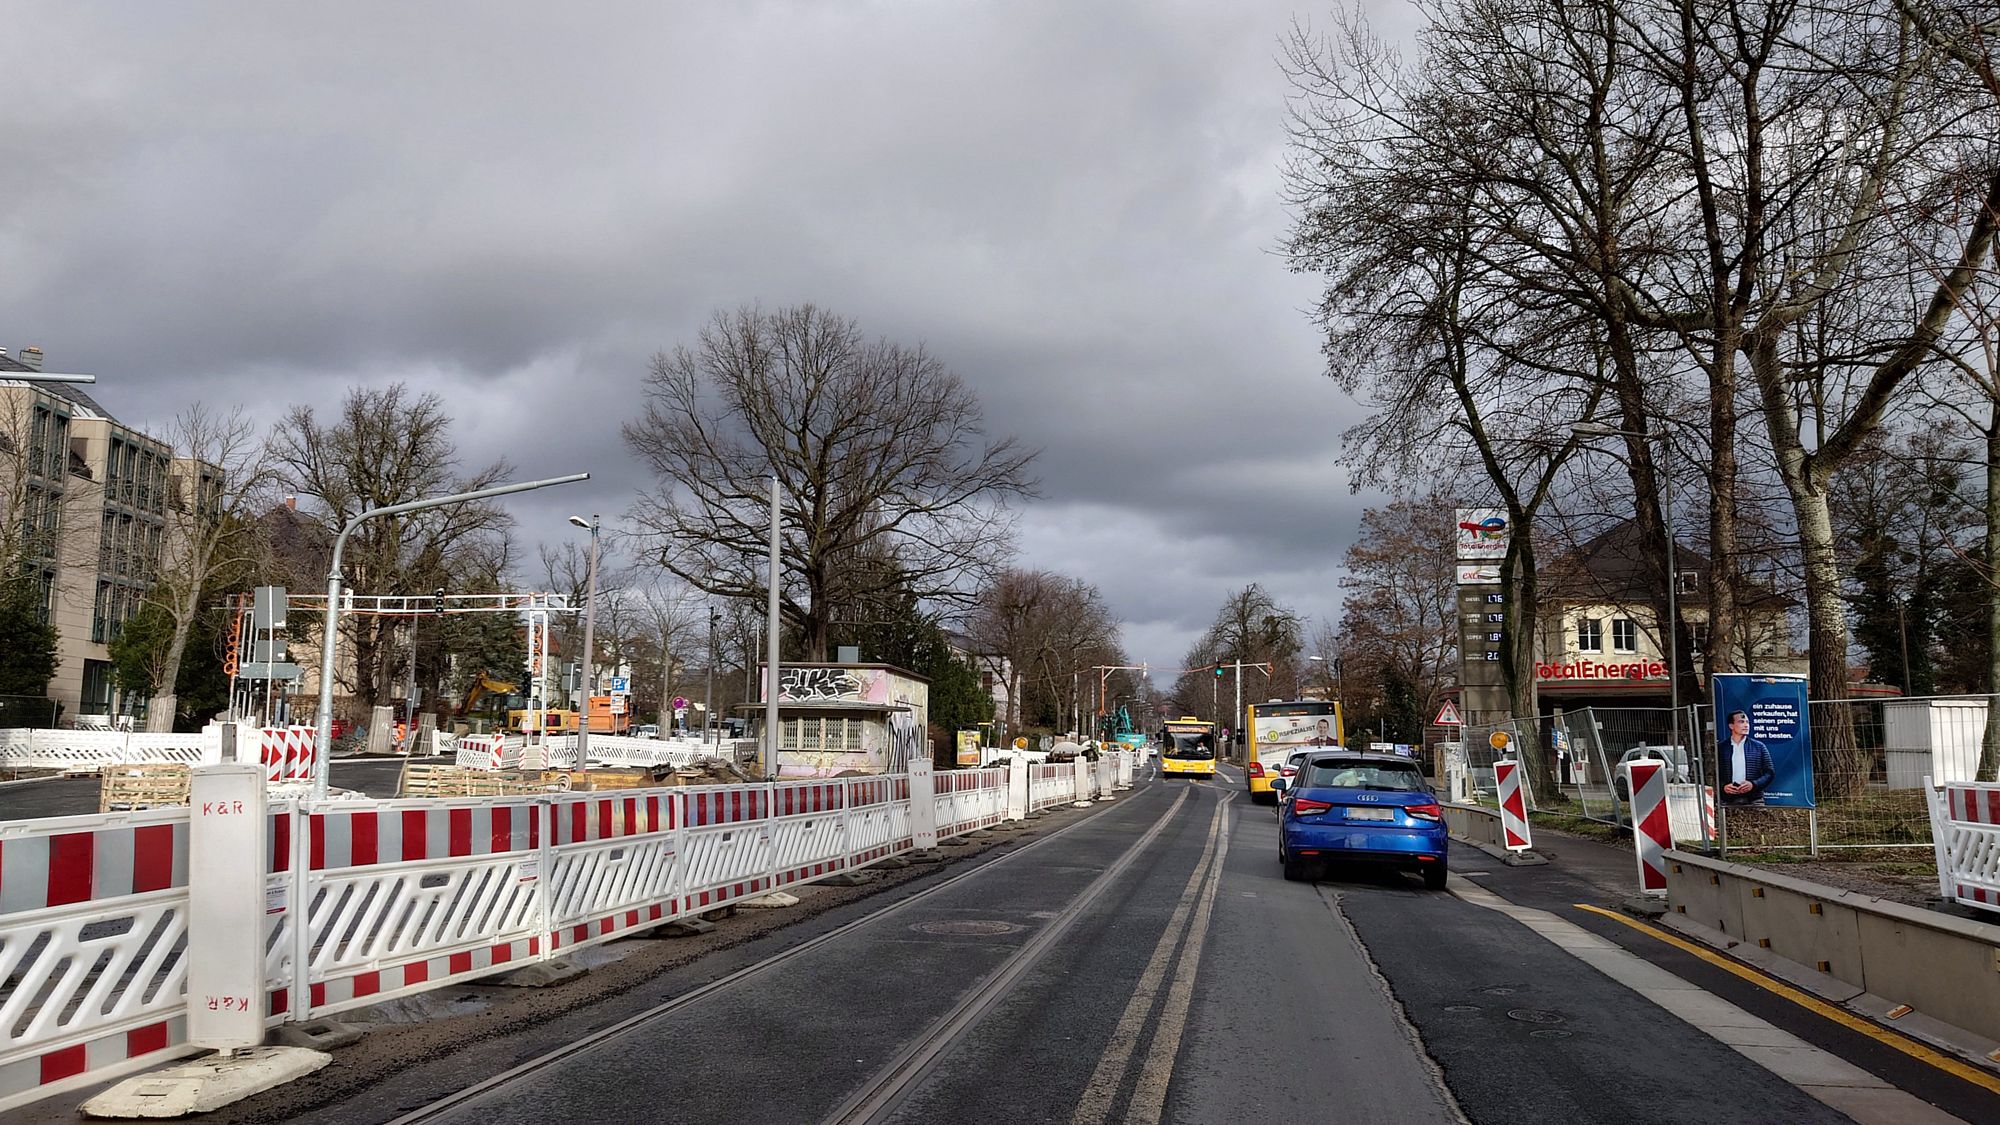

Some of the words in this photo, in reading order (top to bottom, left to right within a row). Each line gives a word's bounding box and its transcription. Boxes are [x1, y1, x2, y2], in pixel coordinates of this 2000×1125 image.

[1459, 542, 1507, 551] TotalEnergies
[203, 802, 213, 816] K
[217, 802, 228, 815] &
[233, 801, 243, 815] R
[207, 996, 218, 1010] R
[223, 996, 234, 1010] &
[238, 997, 248, 1011] K
